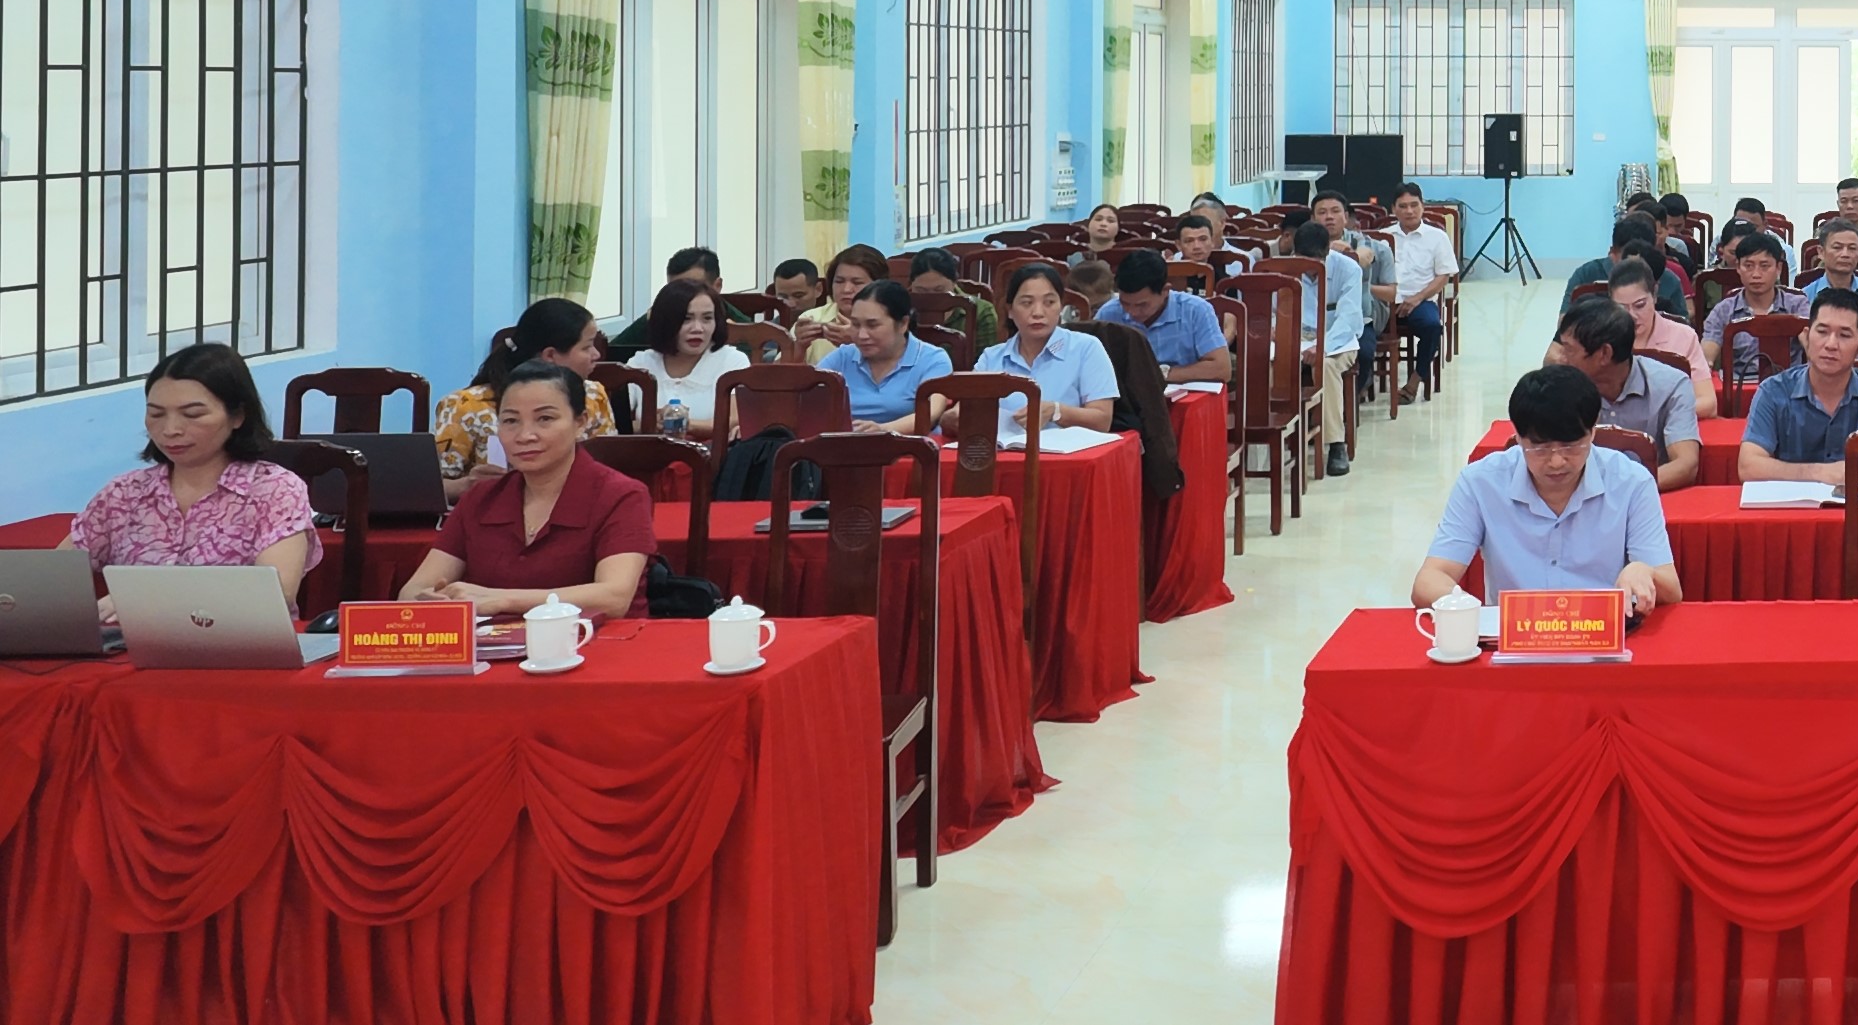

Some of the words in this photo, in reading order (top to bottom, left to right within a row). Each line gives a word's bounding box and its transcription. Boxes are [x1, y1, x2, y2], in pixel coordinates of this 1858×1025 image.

[1534, 616, 1568, 632] QUỐC
[353, 632, 398, 646] HOÀNG
[402, 633, 422, 647] THỊ
